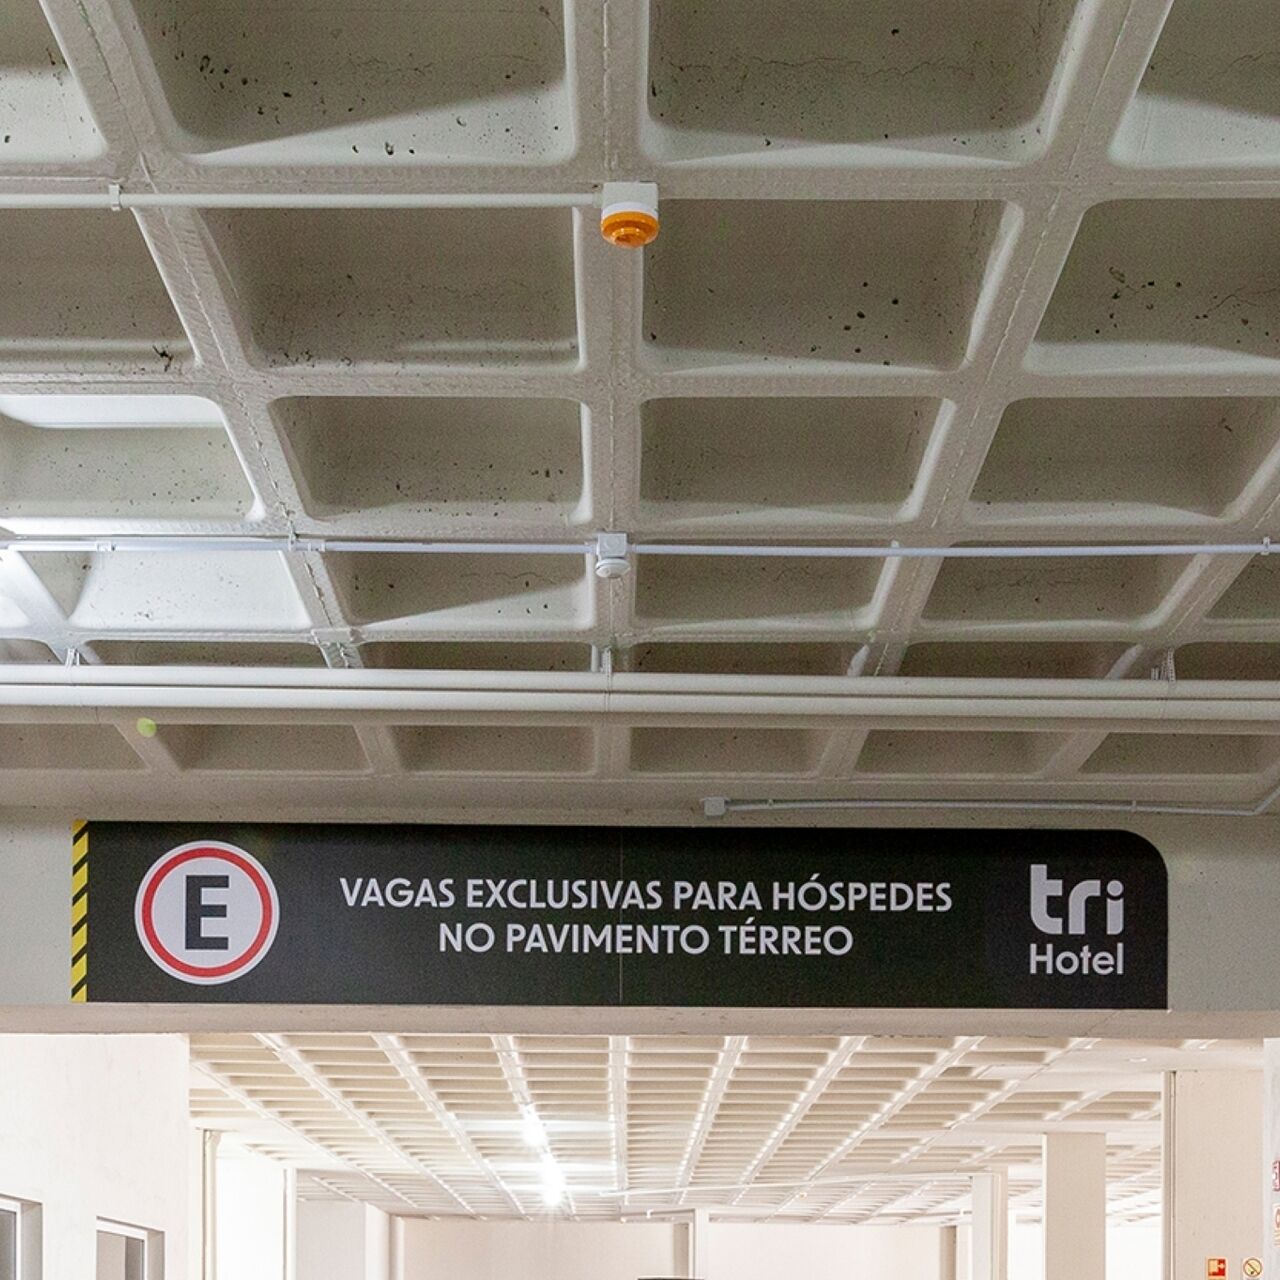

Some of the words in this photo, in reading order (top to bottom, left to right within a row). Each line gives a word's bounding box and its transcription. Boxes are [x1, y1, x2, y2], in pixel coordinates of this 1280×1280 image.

[185, 875, 230, 950] E
[339, 877, 455, 908] VAGAS
[466, 878, 663, 910] EXCLUSIVAS
[674, 880, 763, 911] PARA
[772, 873, 952, 912] HÓSPEDES
[1030, 864, 1124, 935] tri
[439, 922, 495, 953] NO
[506, 923, 710, 955] PAVIMENTO
[718, 916, 853, 956] TÉRREO
[1030, 942, 1124, 975] Hotel
